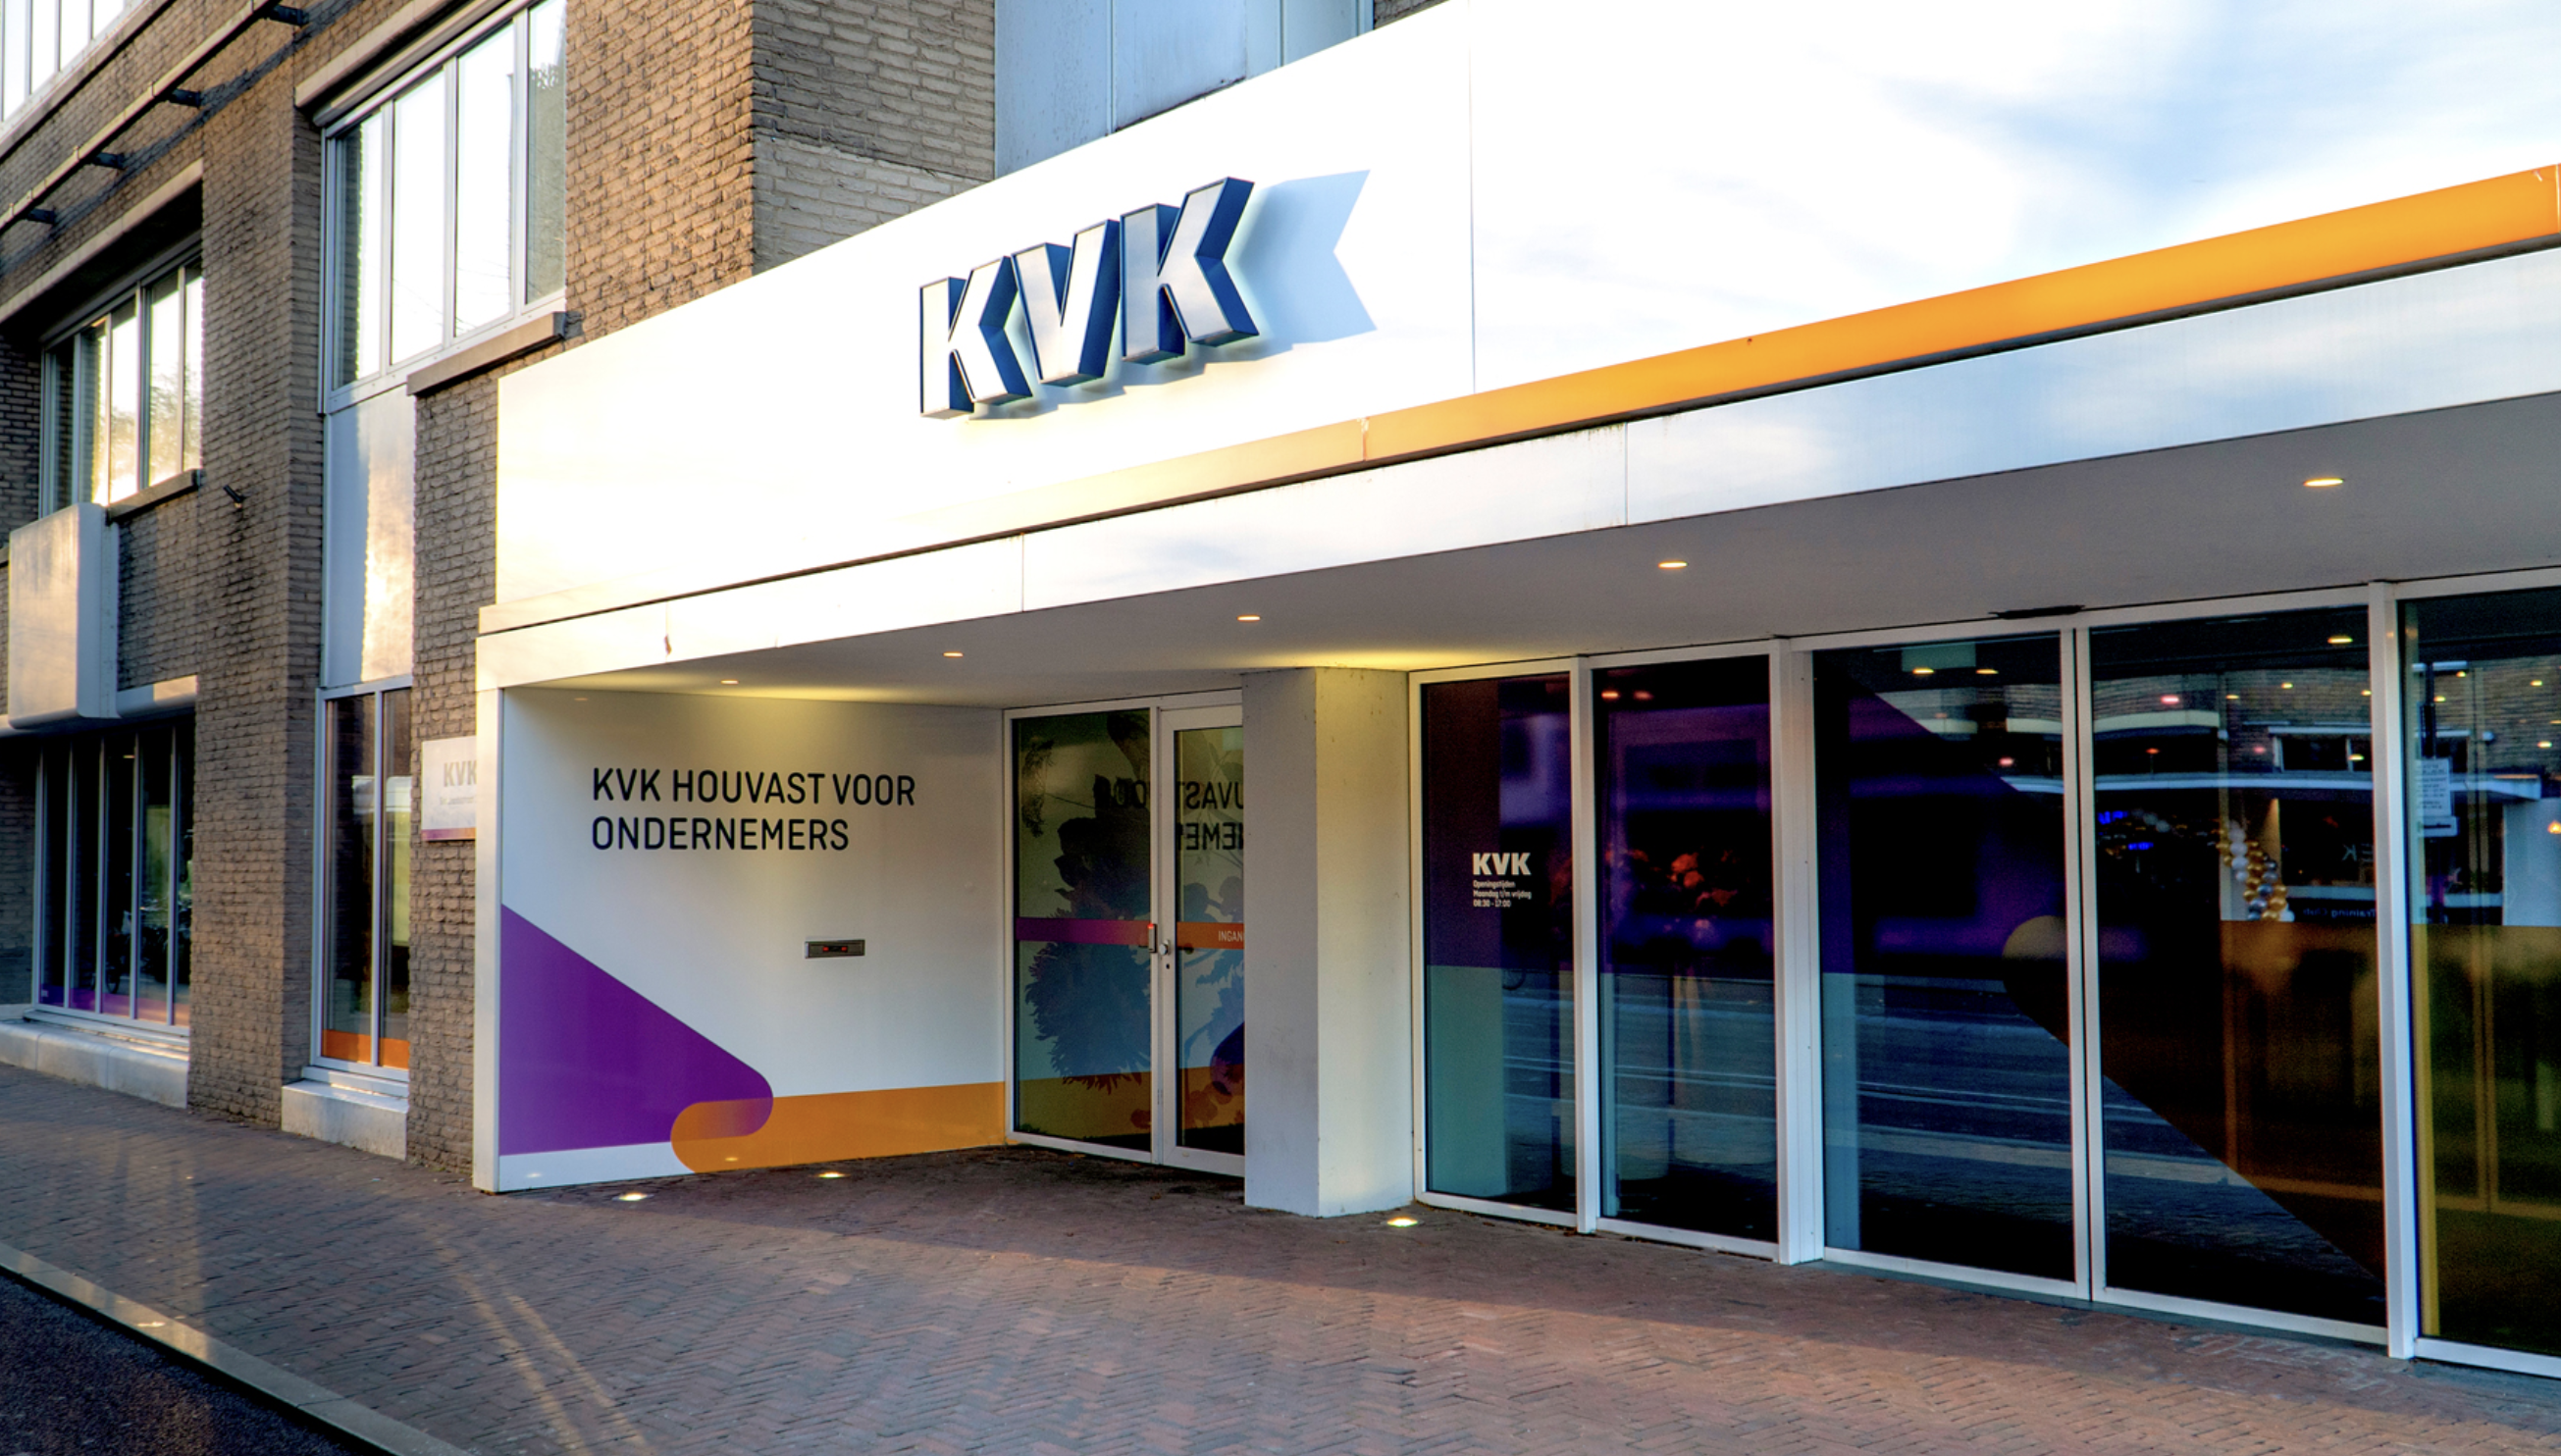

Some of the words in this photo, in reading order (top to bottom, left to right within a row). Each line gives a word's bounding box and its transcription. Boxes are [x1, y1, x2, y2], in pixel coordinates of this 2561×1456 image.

[919, 177, 1259, 419] KVK
[444, 759, 477, 787] KVK
[593, 767, 661, 803] KVK
[672, 768, 826, 805] HOUVAST
[832, 773, 916, 806] VOOR
[592, 815, 849, 852] ONDERNEMERS
[1473, 853, 1531, 875] KVK
[1218, 929, 1243, 942] INGAN
